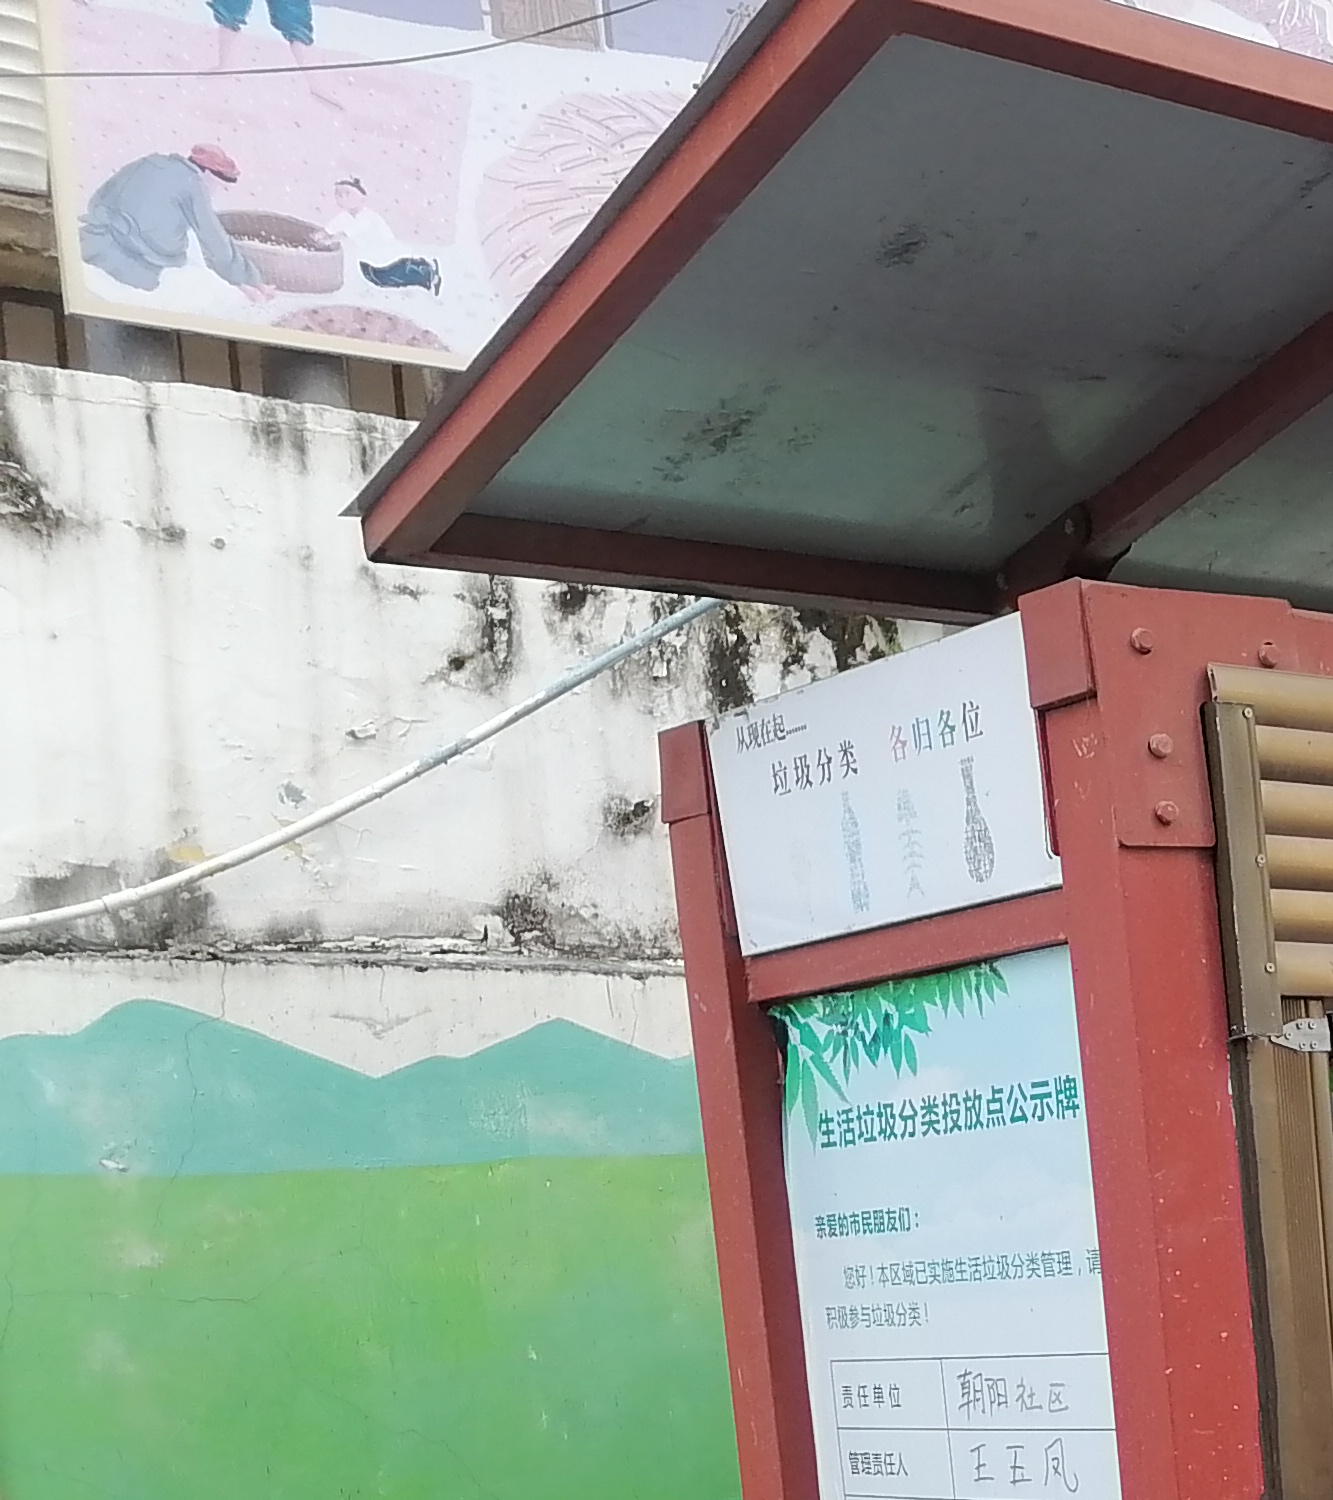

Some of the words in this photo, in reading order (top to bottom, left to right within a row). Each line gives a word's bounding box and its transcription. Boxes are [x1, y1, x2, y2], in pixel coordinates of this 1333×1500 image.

[771, 739, 859, 797] 垃圾分类
[889, 701, 984, 763] 各归各位
[818, 1074, 1080, 1149] 生活垃圾分类投放点公示牌
[957, 1368, 1069, 1421] 朝阳社区
[849, 1451, 908, 1477] 管理责任人
